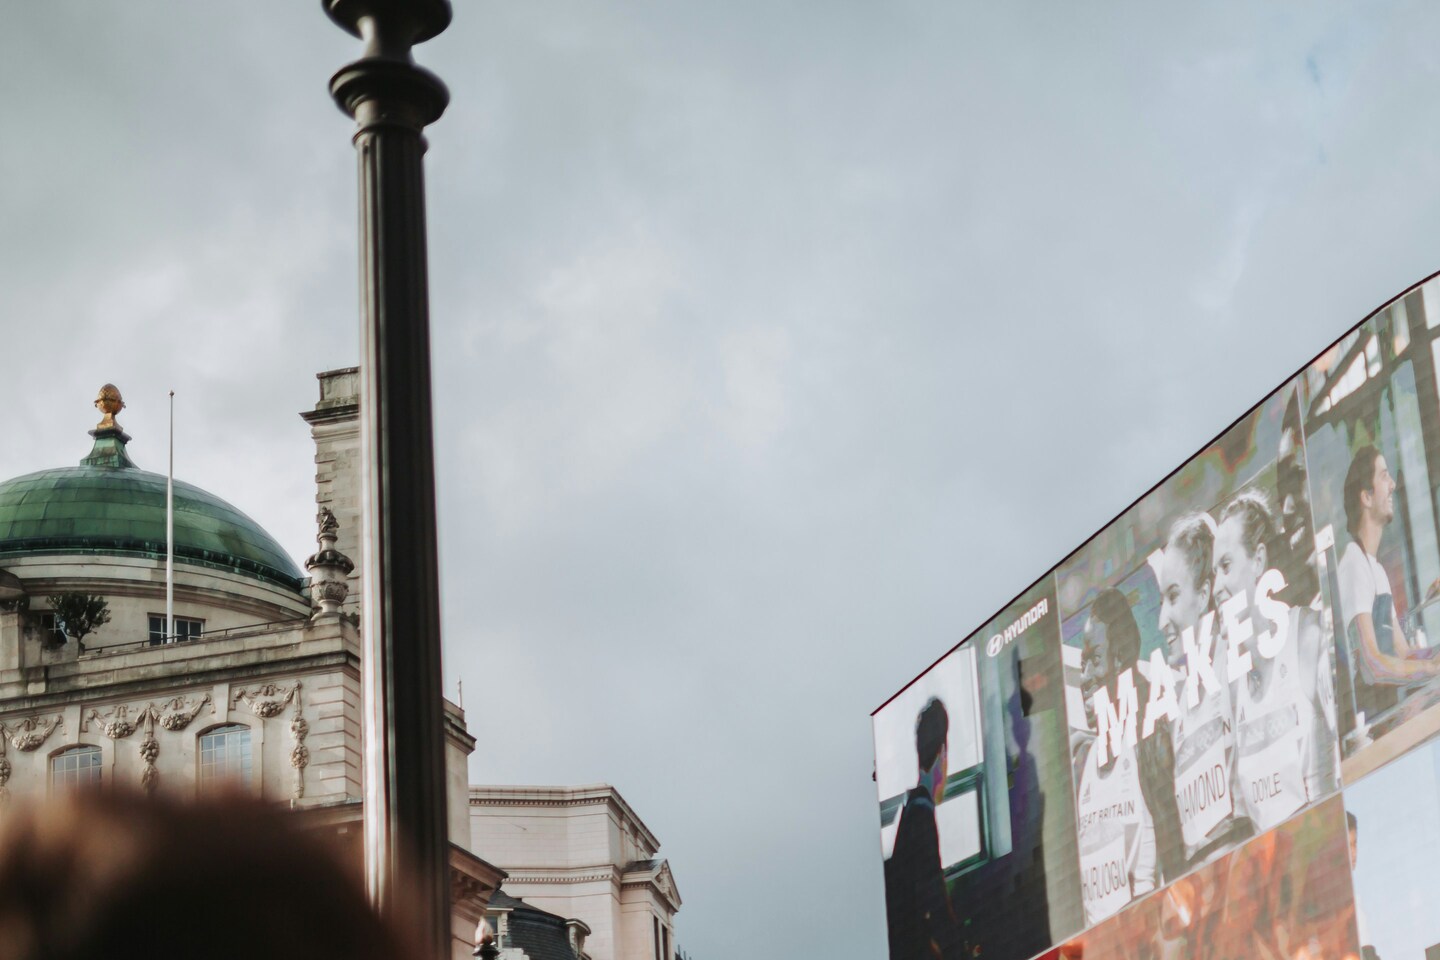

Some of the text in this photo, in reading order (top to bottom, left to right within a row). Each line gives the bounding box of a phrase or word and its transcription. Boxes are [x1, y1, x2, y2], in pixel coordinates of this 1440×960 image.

[1003, 598, 1048, 645] HYUNDAI
[1093, 568, 1289, 768] MAKES
[1251, 772, 1283, 804] DOYLE
